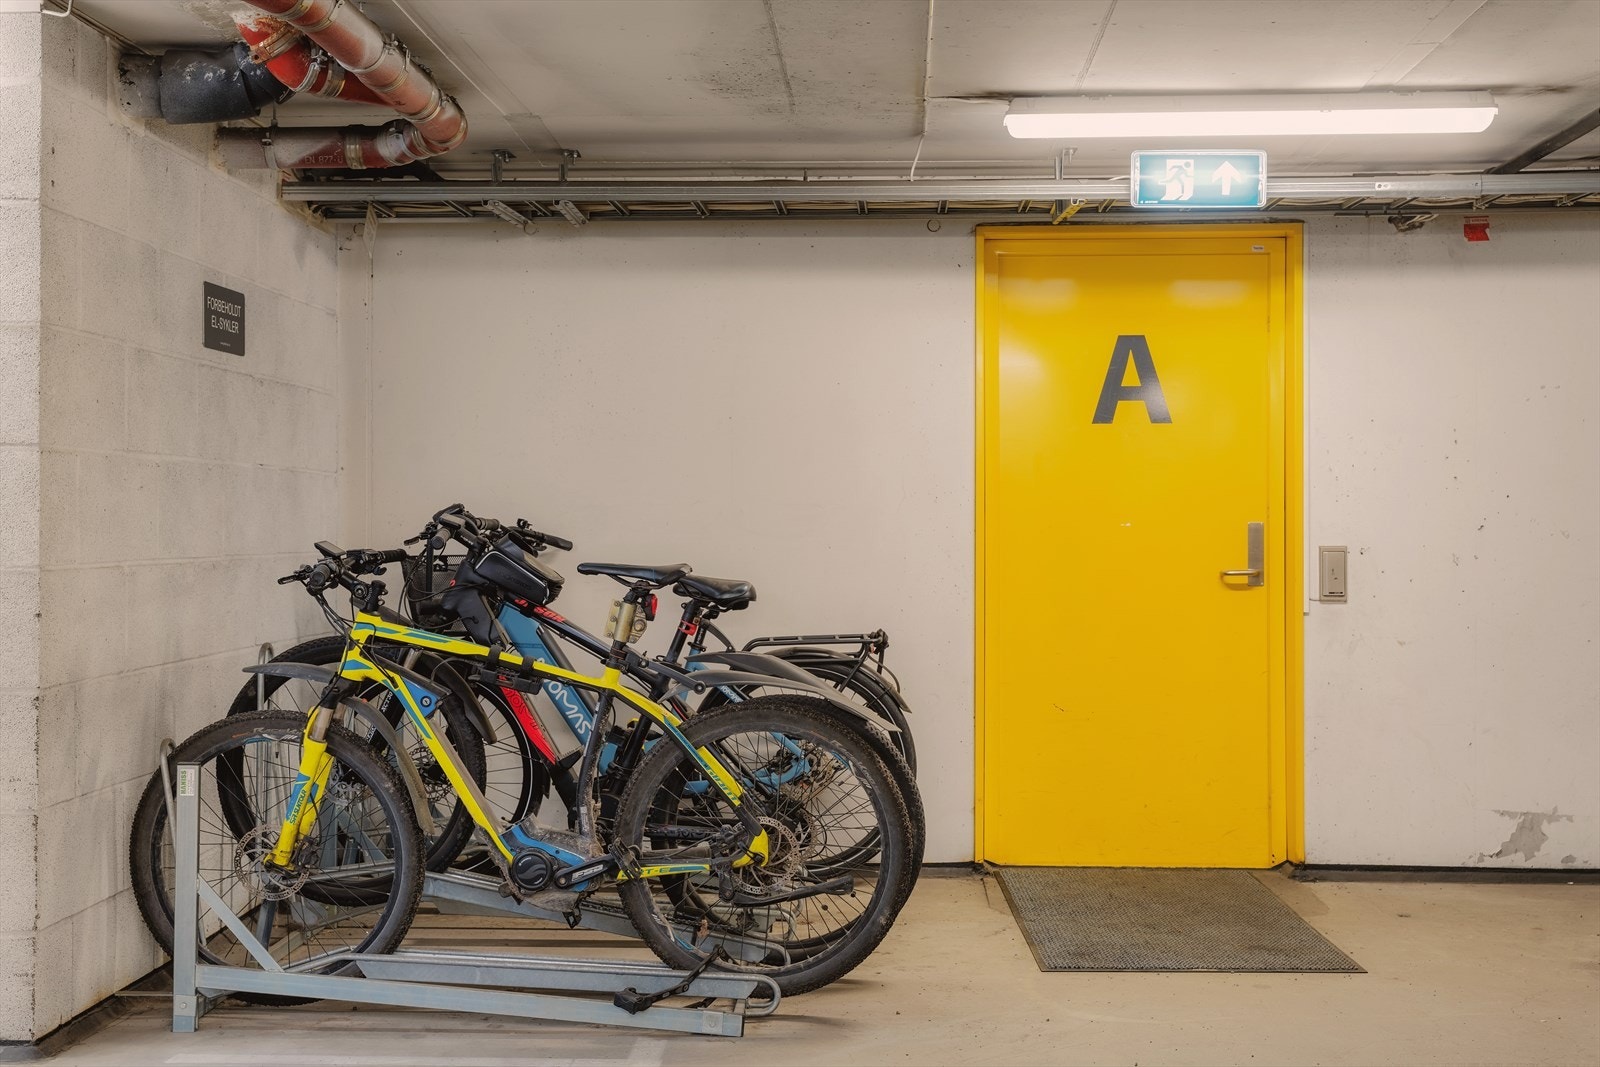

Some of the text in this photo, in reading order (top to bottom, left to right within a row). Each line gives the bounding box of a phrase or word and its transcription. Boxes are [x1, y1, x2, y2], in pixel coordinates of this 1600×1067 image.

[207, 296, 241, 317] FORBEHOLDT
[211, 315, 239, 333] EL-SYKLER
[1092, 335, 1172, 424] A
